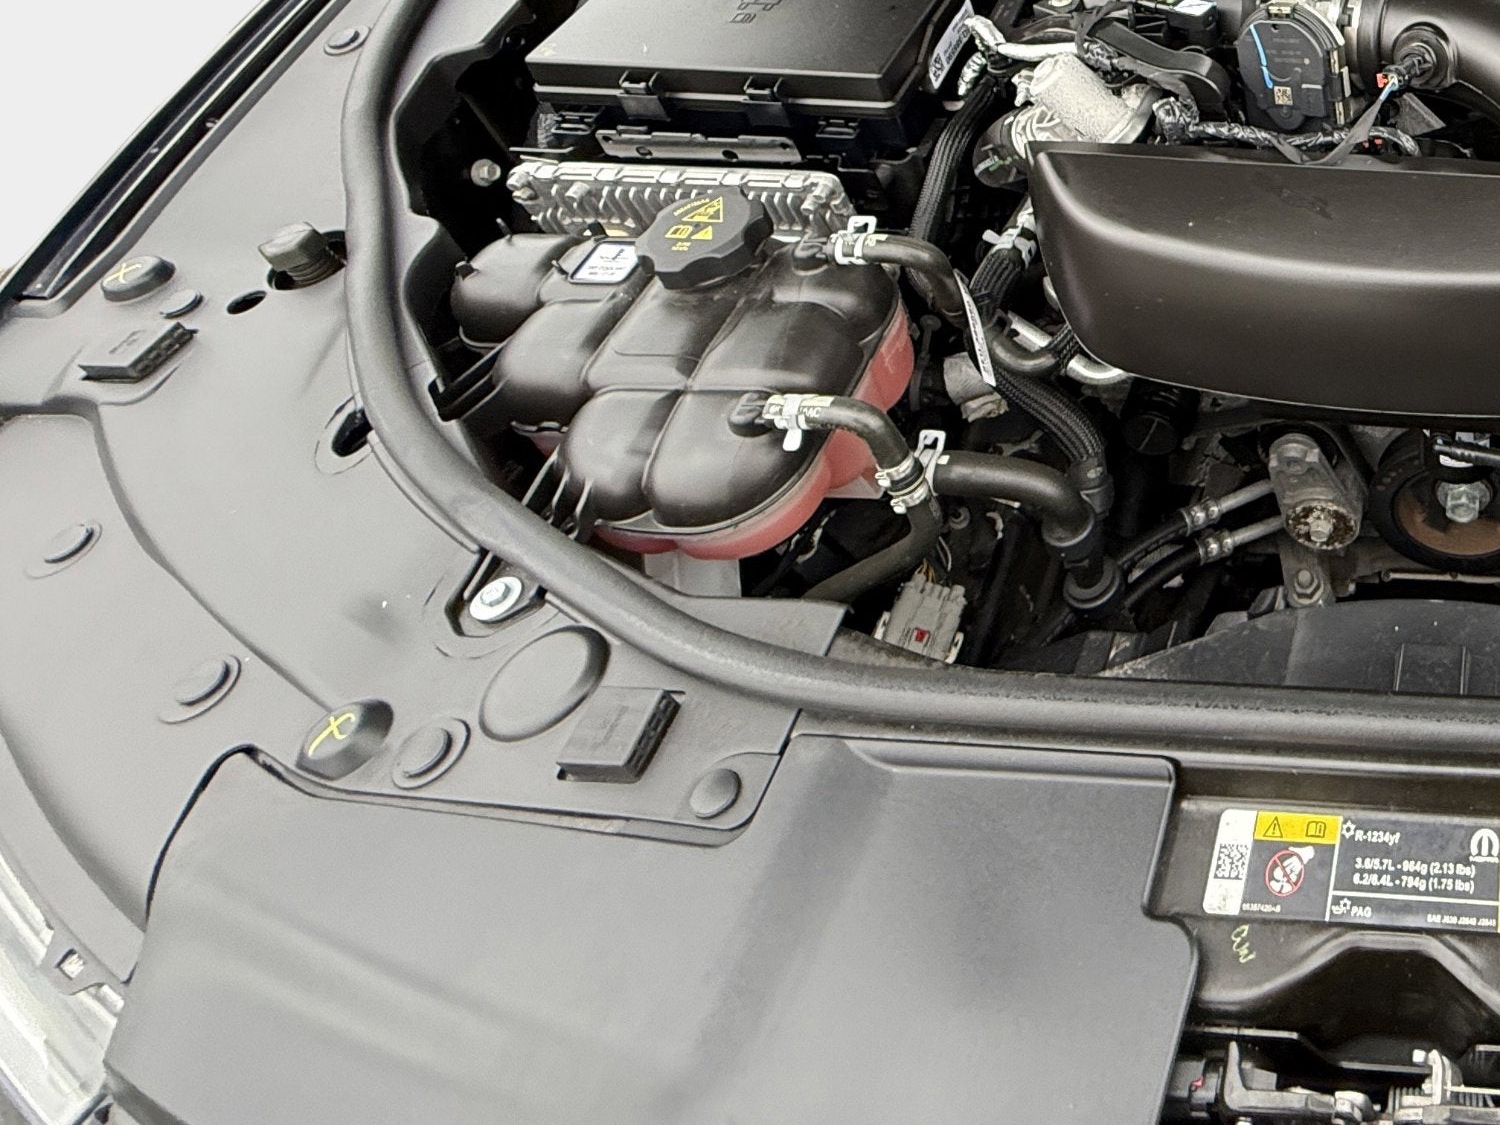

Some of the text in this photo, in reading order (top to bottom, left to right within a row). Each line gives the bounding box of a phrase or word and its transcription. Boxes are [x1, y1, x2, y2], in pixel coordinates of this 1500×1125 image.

[1354, 830, 1401, 846] R-1234yf
[1429, 863, 1454, 876] (2.13
[1455, 864, 1476, 877] lbs)
[1401, 876, 1427, 891] 794g
[1428, 878, 1454, 892] (1.75
[1454, 879, 1475, 893] lbs)
[1350, 905, 1372, 918] PAG
